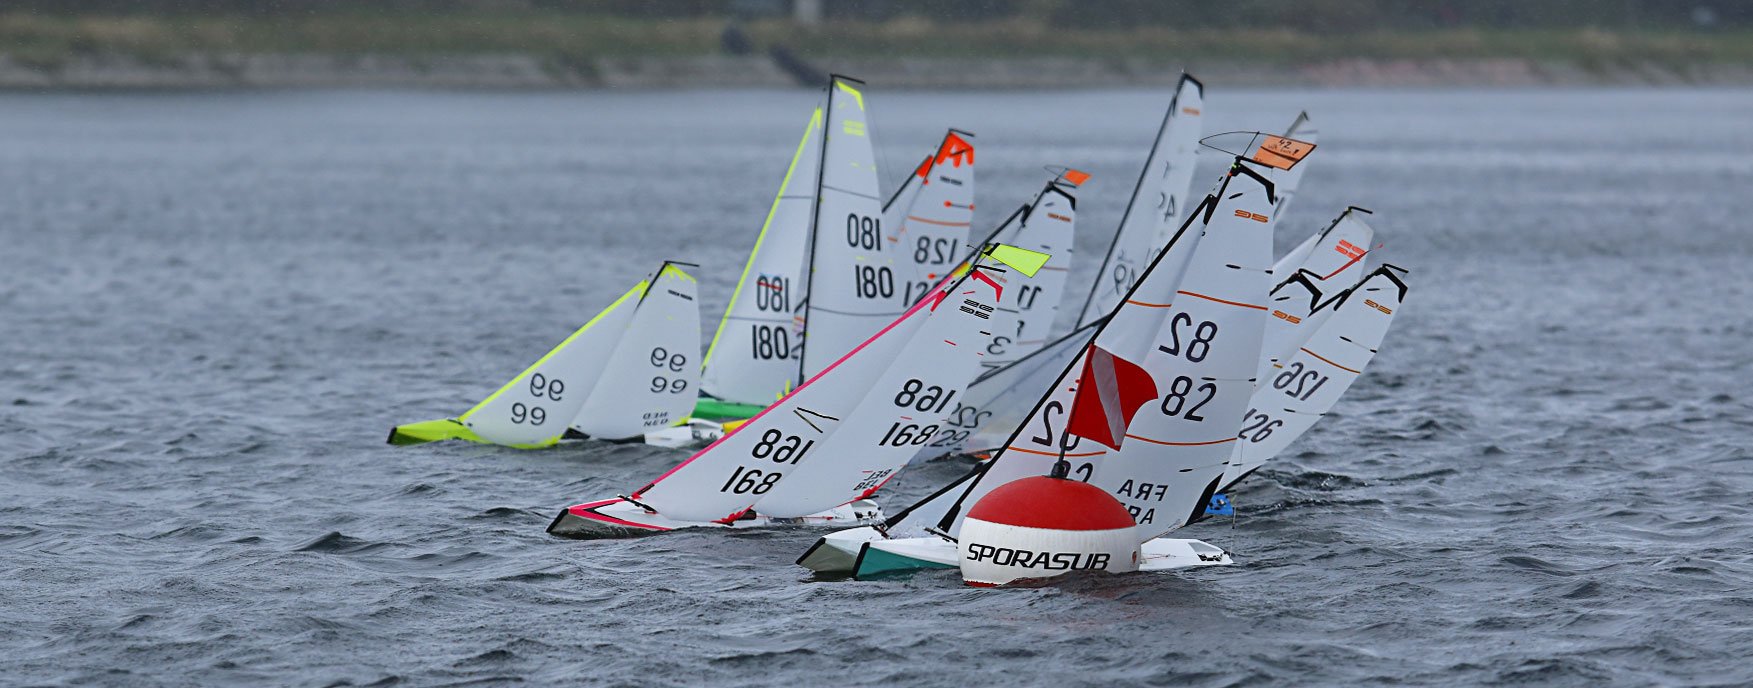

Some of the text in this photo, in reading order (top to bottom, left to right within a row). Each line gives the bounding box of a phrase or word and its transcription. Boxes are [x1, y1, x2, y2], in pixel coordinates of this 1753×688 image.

[855, 264, 894, 299] 180
[903, 281, 939, 307] 12
[752, 325, 790, 360] 180
[650, 376, 687, 394] 99
[1160, 375, 1217, 421] 82
[511, 402, 546, 426] 99
[878, 422, 939, 447] 168
[925, 430, 970, 446] 29
[720, 465, 783, 495] 168
[1120, 502, 1155, 524] RA
[967, 543, 1111, 571] SPORASUB
